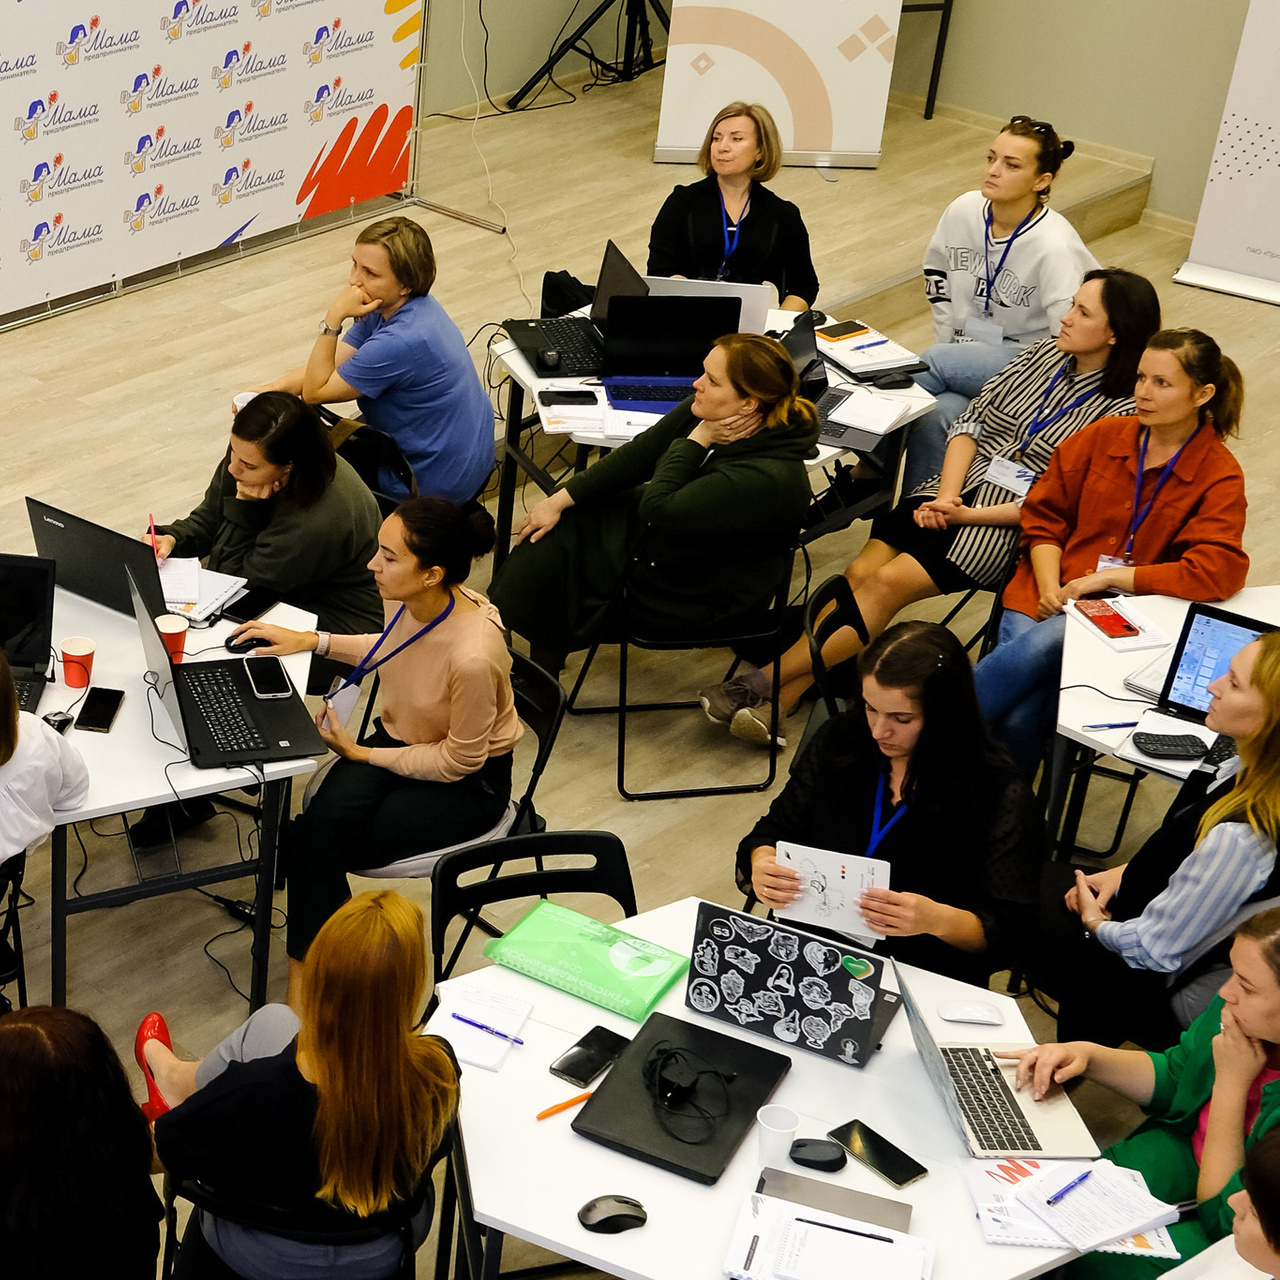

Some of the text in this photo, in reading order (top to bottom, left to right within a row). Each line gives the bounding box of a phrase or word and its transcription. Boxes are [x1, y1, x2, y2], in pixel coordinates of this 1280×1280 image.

[187, 4, 238, 28] Мама
[186, 19, 238, 37] предприниматель
[85, 29, 140, 53] Мама
[327, 30, 374, 52] Мама
[84, 43, 140, 62] предприниматель
[326, 43, 374, 61] предприниматель
[237, 53, 287, 77] Мама
[236, 67, 287, 85] предприниматель
[147, 77, 199, 101] Мама
[146, 90, 199, 109] предприниматель
[327, 88, 374, 111] Мама
[327, 101, 374, 118] предприниматель
[43, 103, 99, 128] Мама
[239, 112, 288, 136] Мама
[43, 118, 100, 136] предприниматель
[238, 125, 288, 144] предприниматель
[150, 136, 202, 161] Мама
[150, 151, 202, 169] предприниматель
[48, 165, 103, 190] Мама
[237, 168, 285, 192] Мама
[48, 179, 104, 198] предприниматель
[236, 182, 285, 200] предприниматель
[149, 194, 200, 218] Мама
[149, 209, 200, 227] предприниматель
[48, 223, 103, 248] Мама
[48, 237, 103, 256] предприниматель
